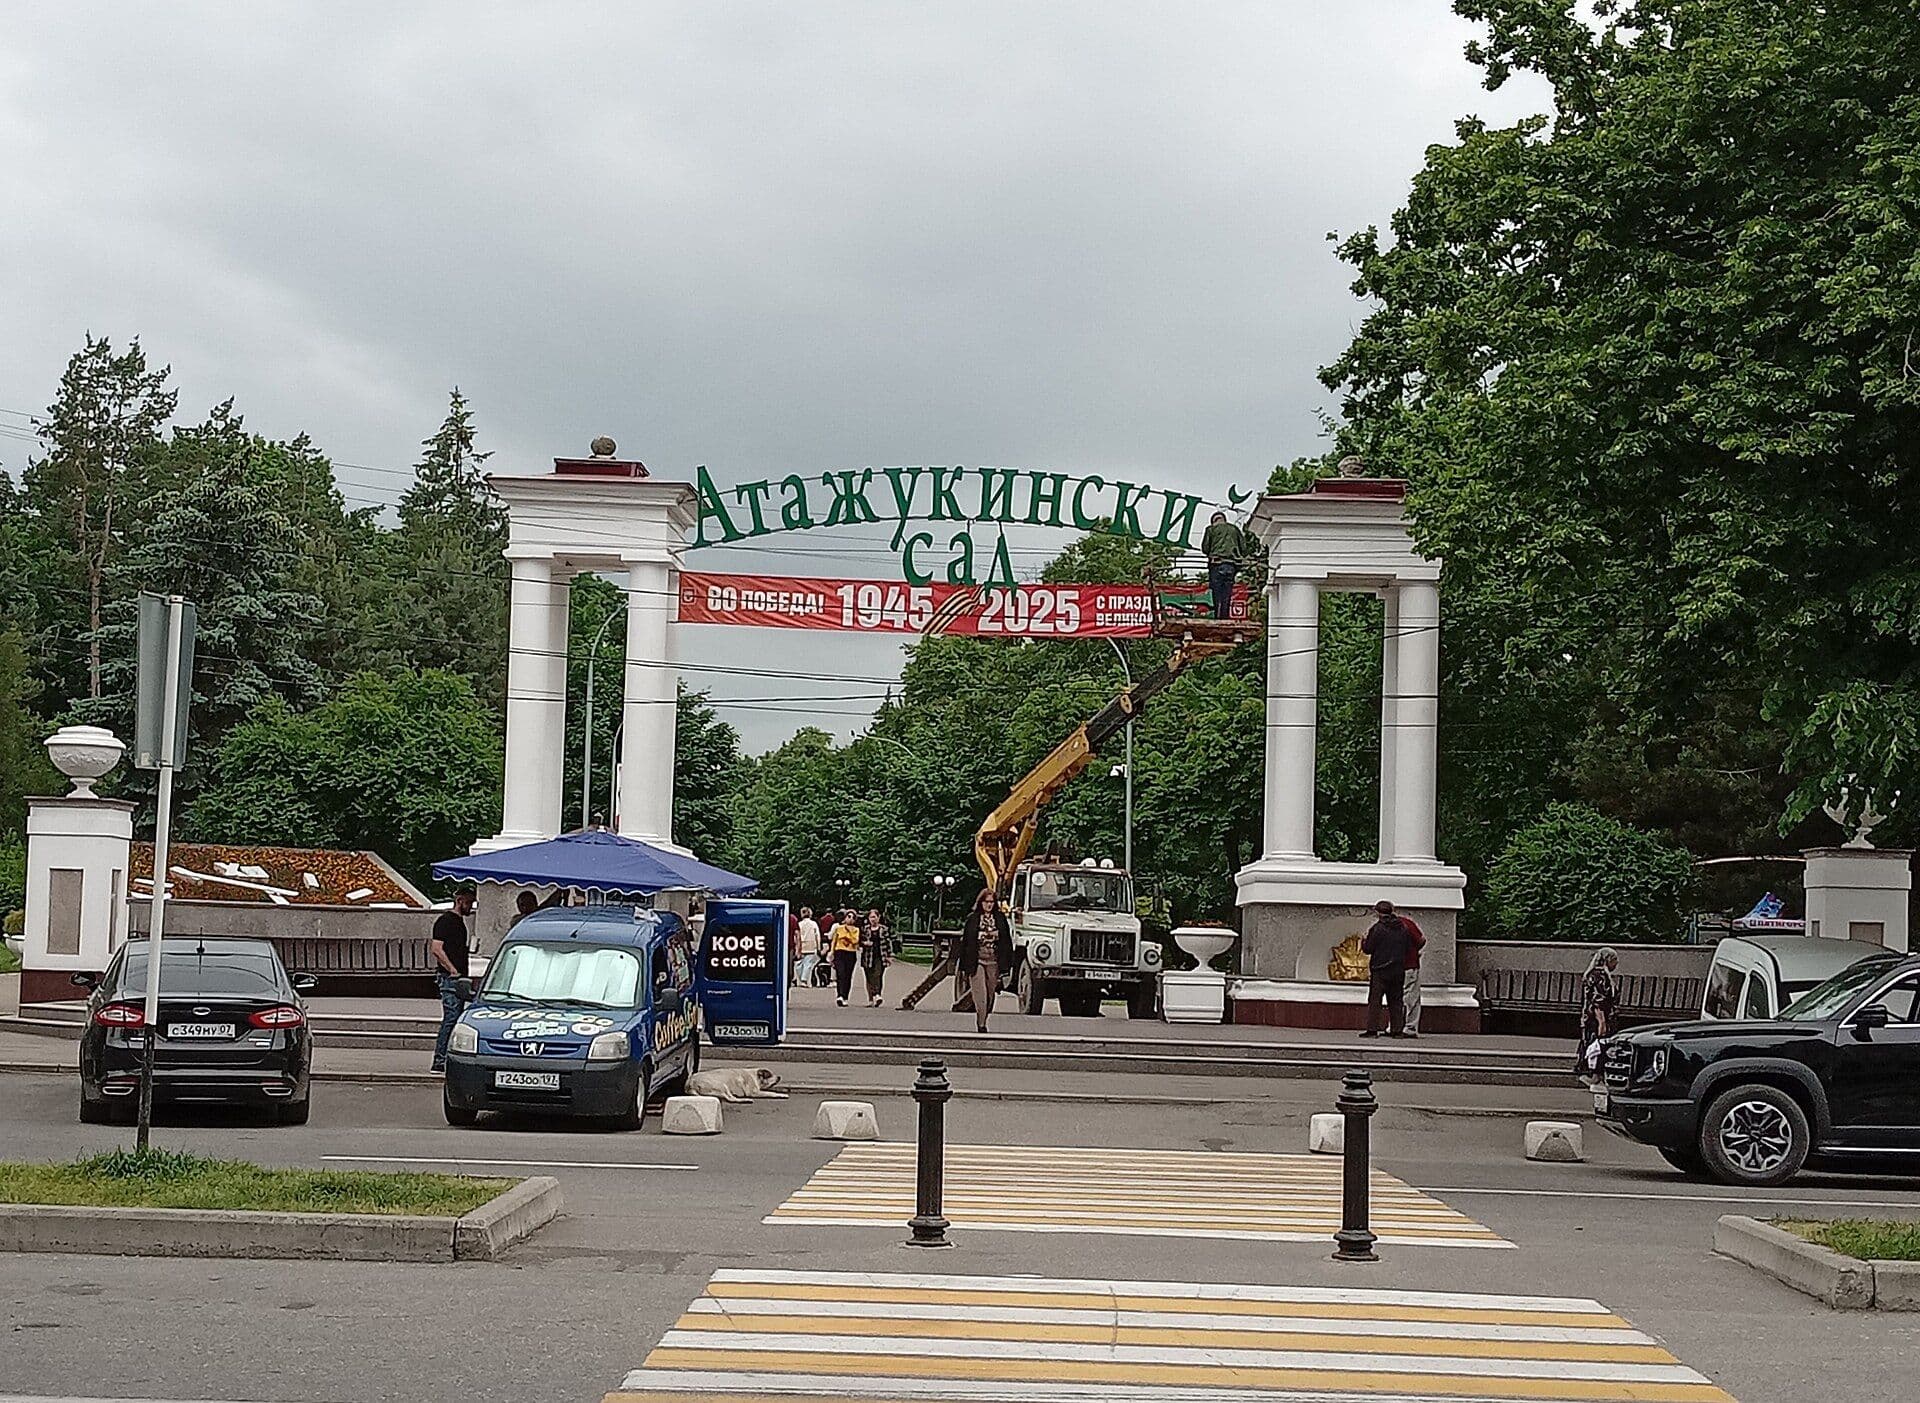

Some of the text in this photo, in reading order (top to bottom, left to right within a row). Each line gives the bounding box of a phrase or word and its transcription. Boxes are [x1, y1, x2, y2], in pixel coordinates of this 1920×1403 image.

[692, 465, 1252, 552] Атажукински
[741, 590, 825, 616] ПОБЕДА!
[837, 585, 1081, 633] 1945 2025
[1108, 596, 1161, 611] ПРАЗД
[712, 936, 765, 951] КОФЕ
[722, 955, 766, 968] собой
